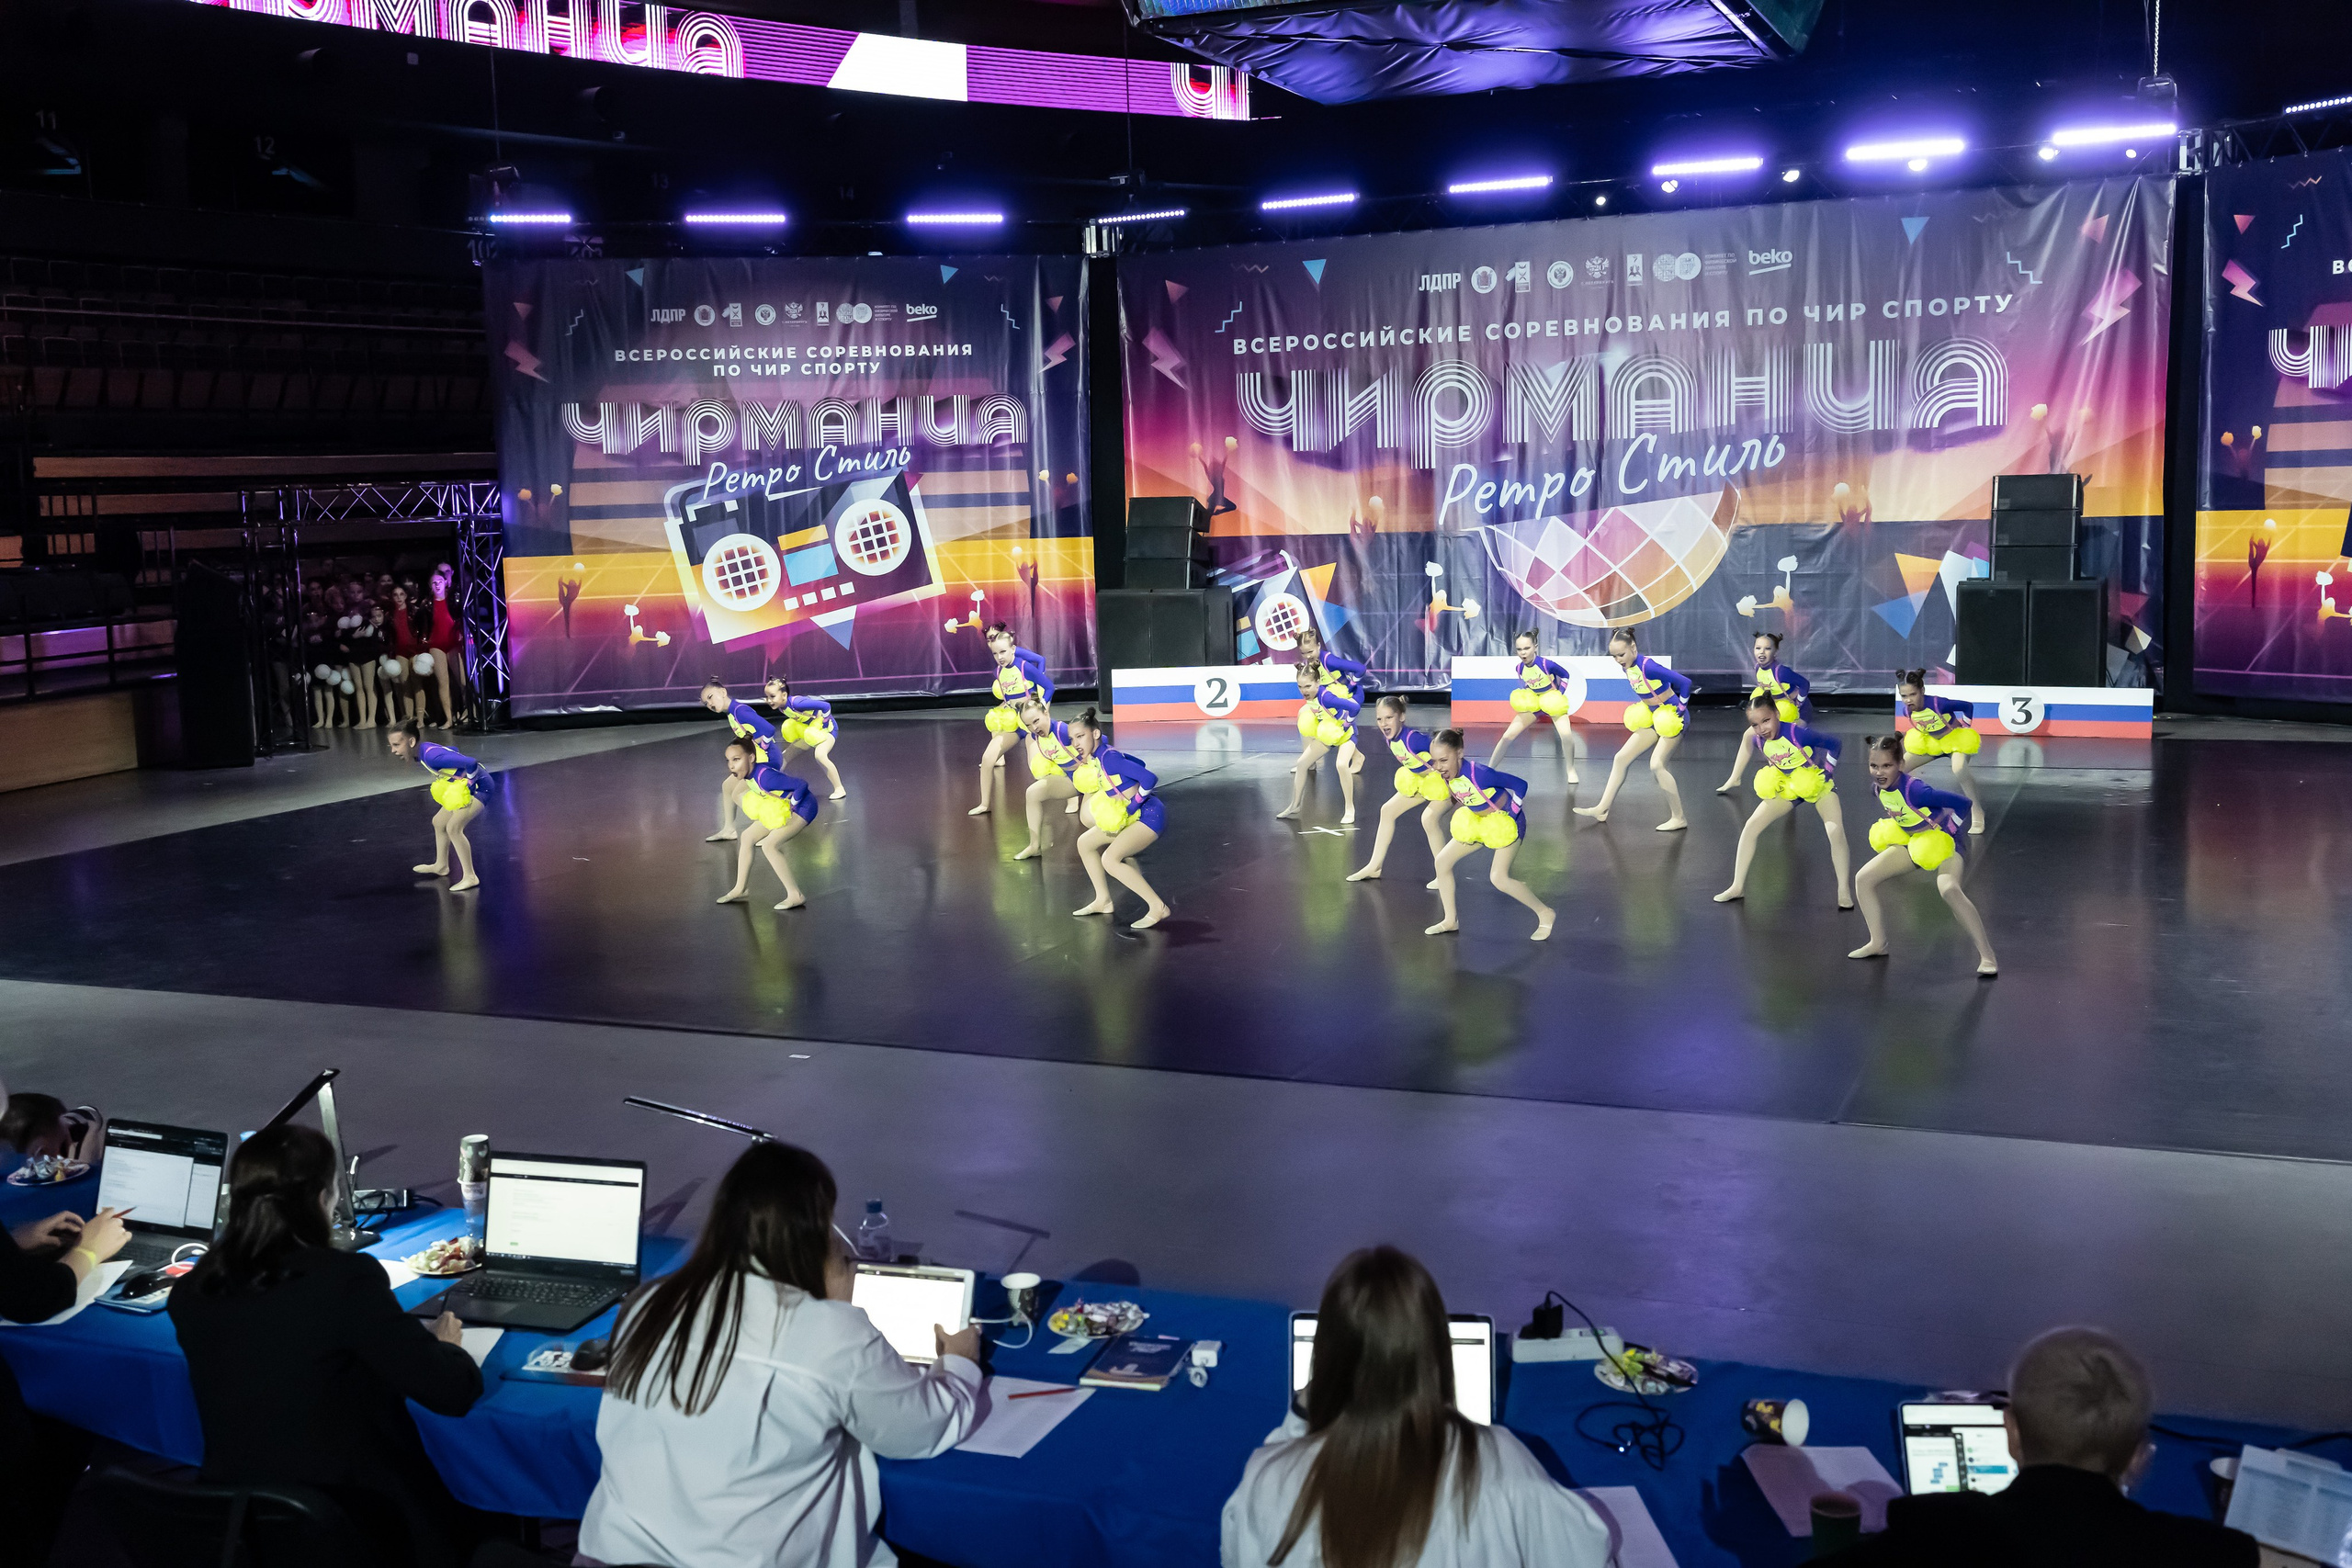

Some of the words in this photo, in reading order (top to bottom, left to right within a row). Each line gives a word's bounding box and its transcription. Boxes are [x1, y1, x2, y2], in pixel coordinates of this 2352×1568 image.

[254, 135, 275, 155] 12
[1748, 249, 1793, 265] beko
[2332, 259, 2352, 275] В
[1419, 272, 1461, 293] ЛДПР
[650, 309, 686, 323] ЛДПР
[906, 303, 938, 315] beko
[1233, 325, 1471, 355] ВСЕРОССИЙСКИЕ
[1485, 310, 1730, 341] СОРЕВНОВАНИЯ
[1747, 307, 1788, 326] ПО
[1804, 303, 1866, 321] ЧИР
[1883, 294, 2013, 319] СПОРТУ
[615, 345, 797, 362] ВСЕРОССИЙСКИЕ
[806, 344, 972, 358] СОРЕВНОВАНИЯ
[713, 364, 741, 377] ПО
[750, 364, 791, 376] ЧИР
[800, 362, 880, 375] СПОРТУ
[703, 461, 801, 501] Ретро
[814, 445, 911, 481] Стиль
[1438, 463, 1596, 525] Ретро
[1618, 433, 1786, 494] Стиль
[1205, 677, 1228, 708] 2
[2010, 696, 2032, 726] 3
